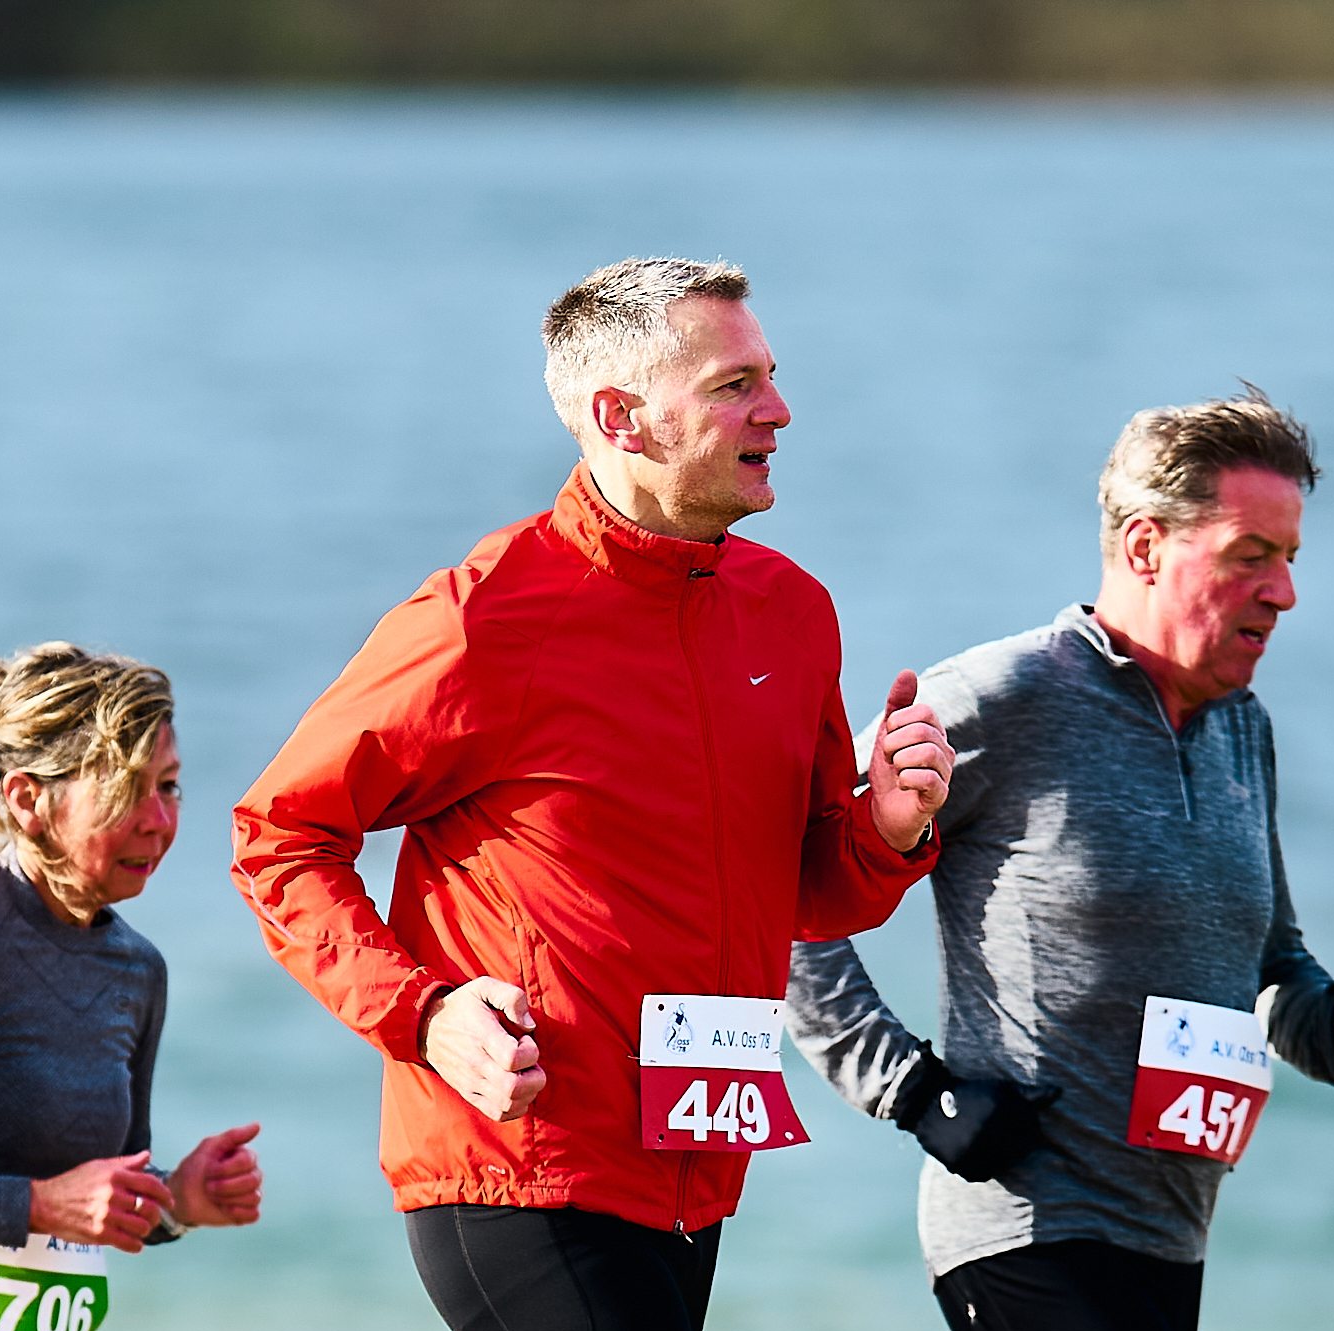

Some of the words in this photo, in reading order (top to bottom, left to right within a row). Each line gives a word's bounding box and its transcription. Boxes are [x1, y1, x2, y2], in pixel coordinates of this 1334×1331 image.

[712, 1030, 738, 1046] A.V.
[741, 1031, 756, 1049] Oss
[668, 1079, 771, 1144] 449
[1158, 1084, 1252, 1156] 451
